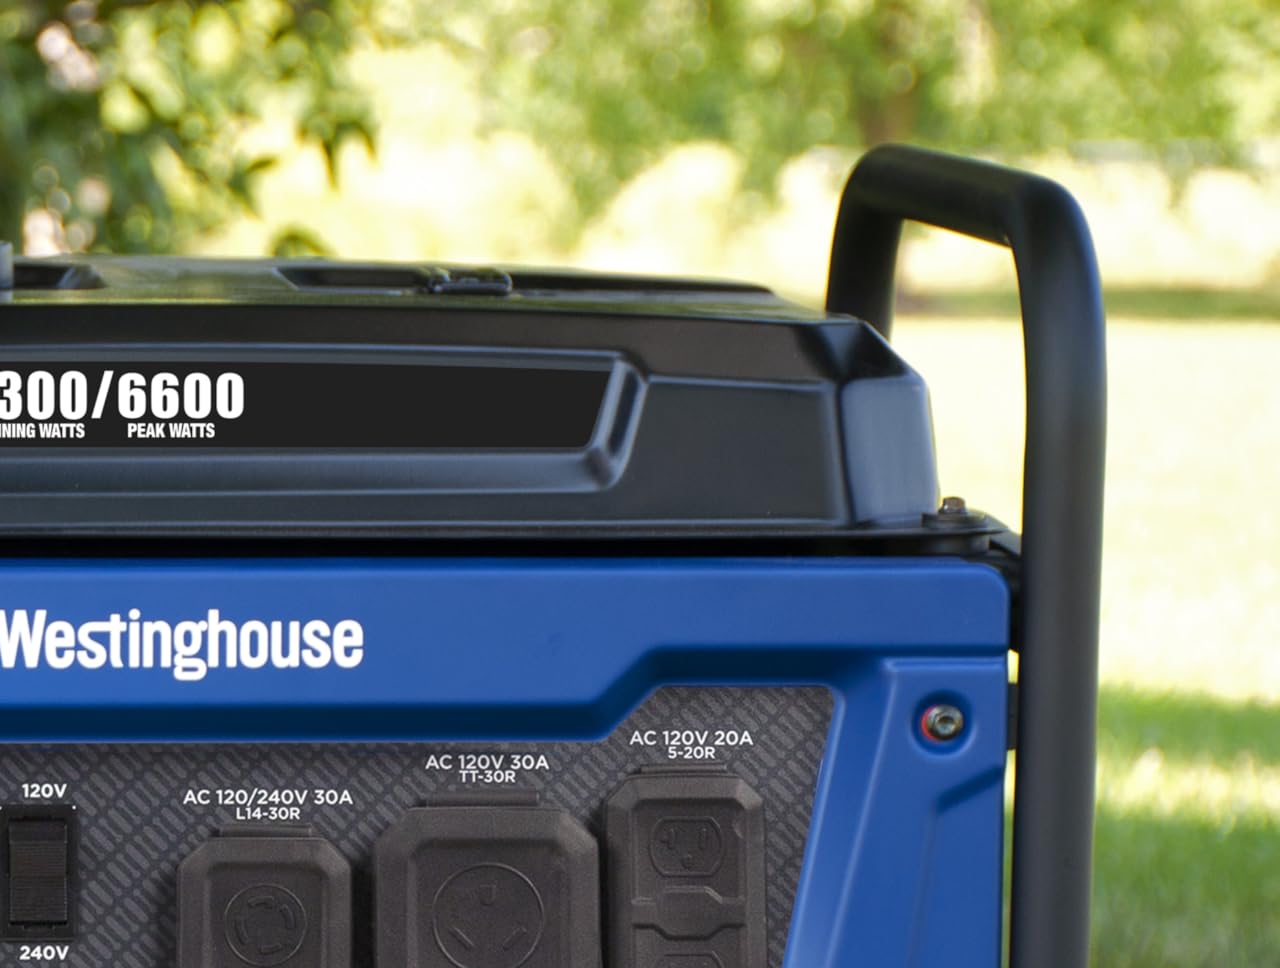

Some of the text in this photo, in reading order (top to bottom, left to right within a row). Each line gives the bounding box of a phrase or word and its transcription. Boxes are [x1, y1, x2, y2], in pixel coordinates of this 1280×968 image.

[40, 423, 85, 438] WATTS
[128, 423, 215, 438] PEAK WATTS
[630, 731, 753, 746] AC 120V 20A
[668, 747, 716, 759] 5-20R
[425, 755, 549, 770] AC 120V 30A
[459, 771, 516, 783] TT-30R
[22, 784, 67, 798] 120V
[183, 788, 353, 806] AC 120/240V 30A
[236, 808, 300, 820] L14-30R
[20, 946, 69, 960] 240V
